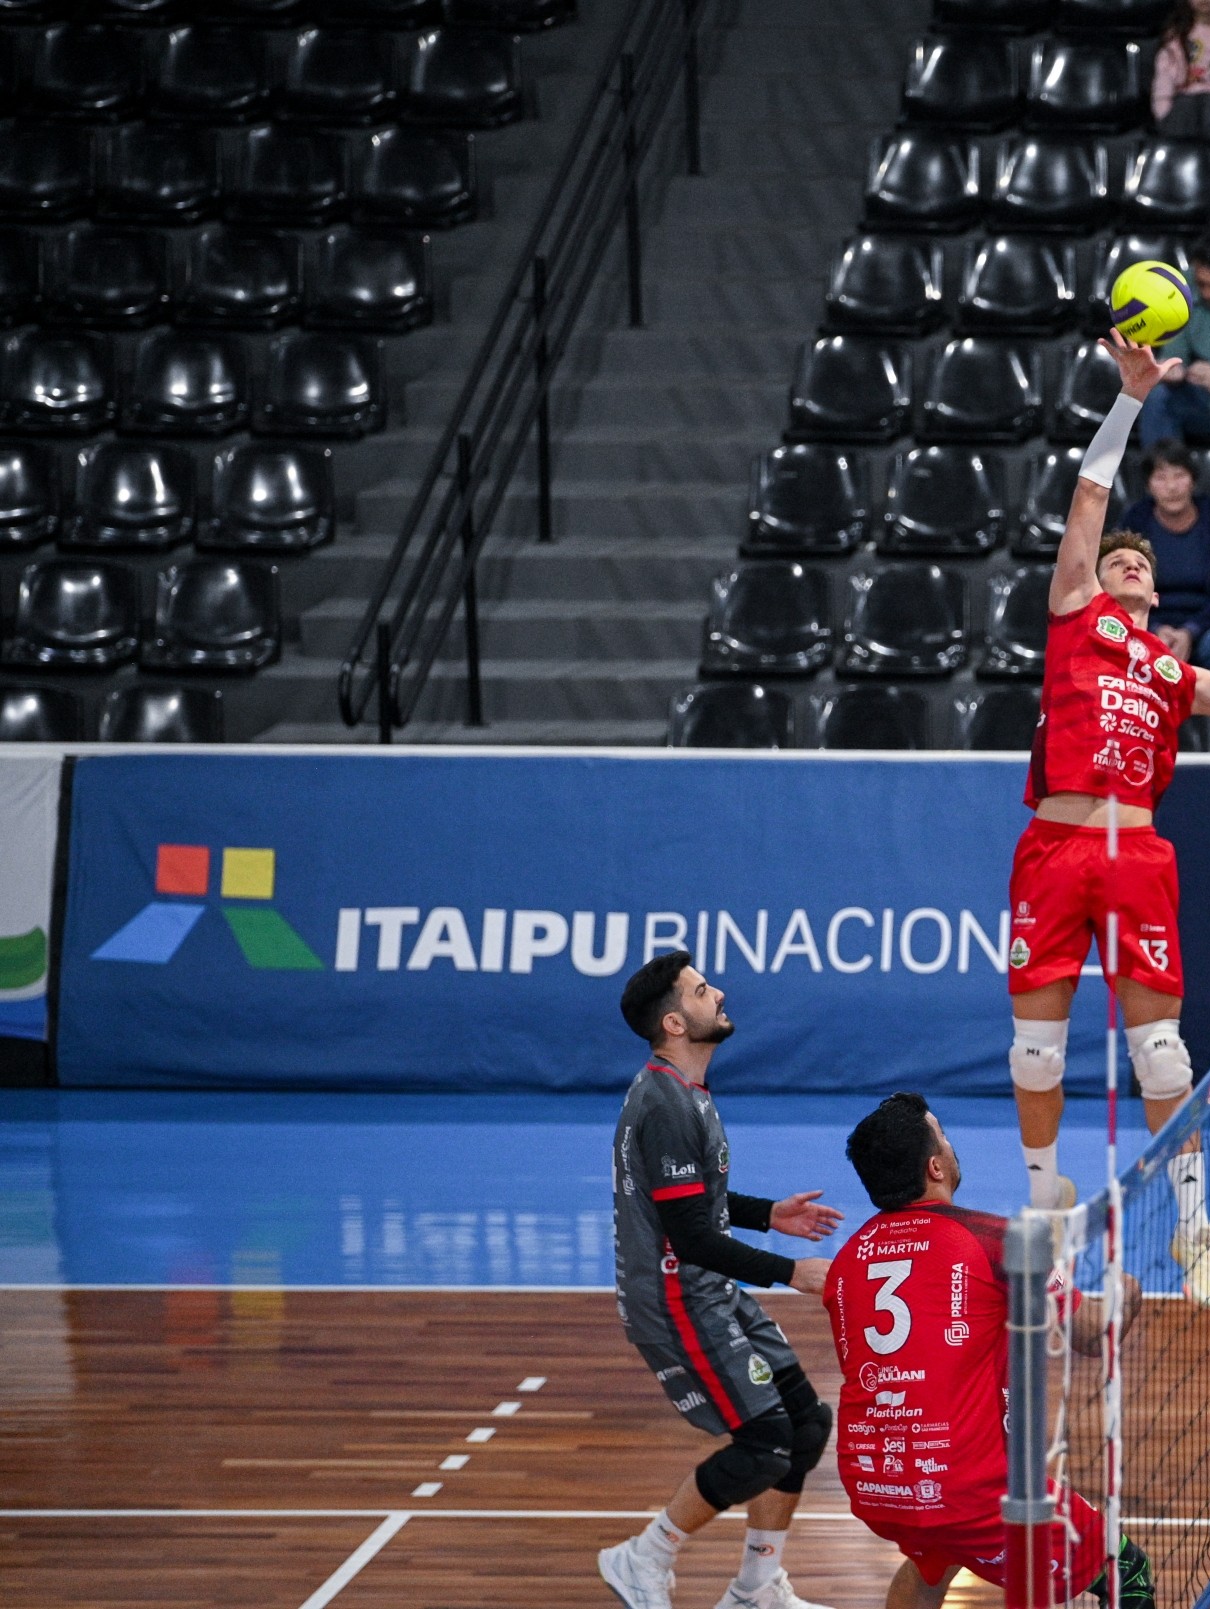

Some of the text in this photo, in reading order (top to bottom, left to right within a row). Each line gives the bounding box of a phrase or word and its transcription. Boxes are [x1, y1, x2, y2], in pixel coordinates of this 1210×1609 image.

[1100, 690, 1159, 729] Dallo
[335, 906, 1106, 976] ITAIPU BINACION
[1138, 938, 1169, 973] 13
[670, 1163, 696, 1176] Loli
[889, 1220, 911, 1228] Mauro
[877, 1240, 930, 1256] MARTINI
[951, 1262, 964, 1318] PRECISA
[863, 1259, 913, 1355] 3
[878, 1369, 926, 1383] ZULIANI
[866, 1405, 923, 1420] Plastiplan
[847, 1423, 876, 1436] coagro
[882, 1437, 906, 1453] Sesi
[915, 1457, 935, 1467] Buti
[921, 1463, 948, 1475] quim
[856, 1480, 914, 1496] CAPANEMA
